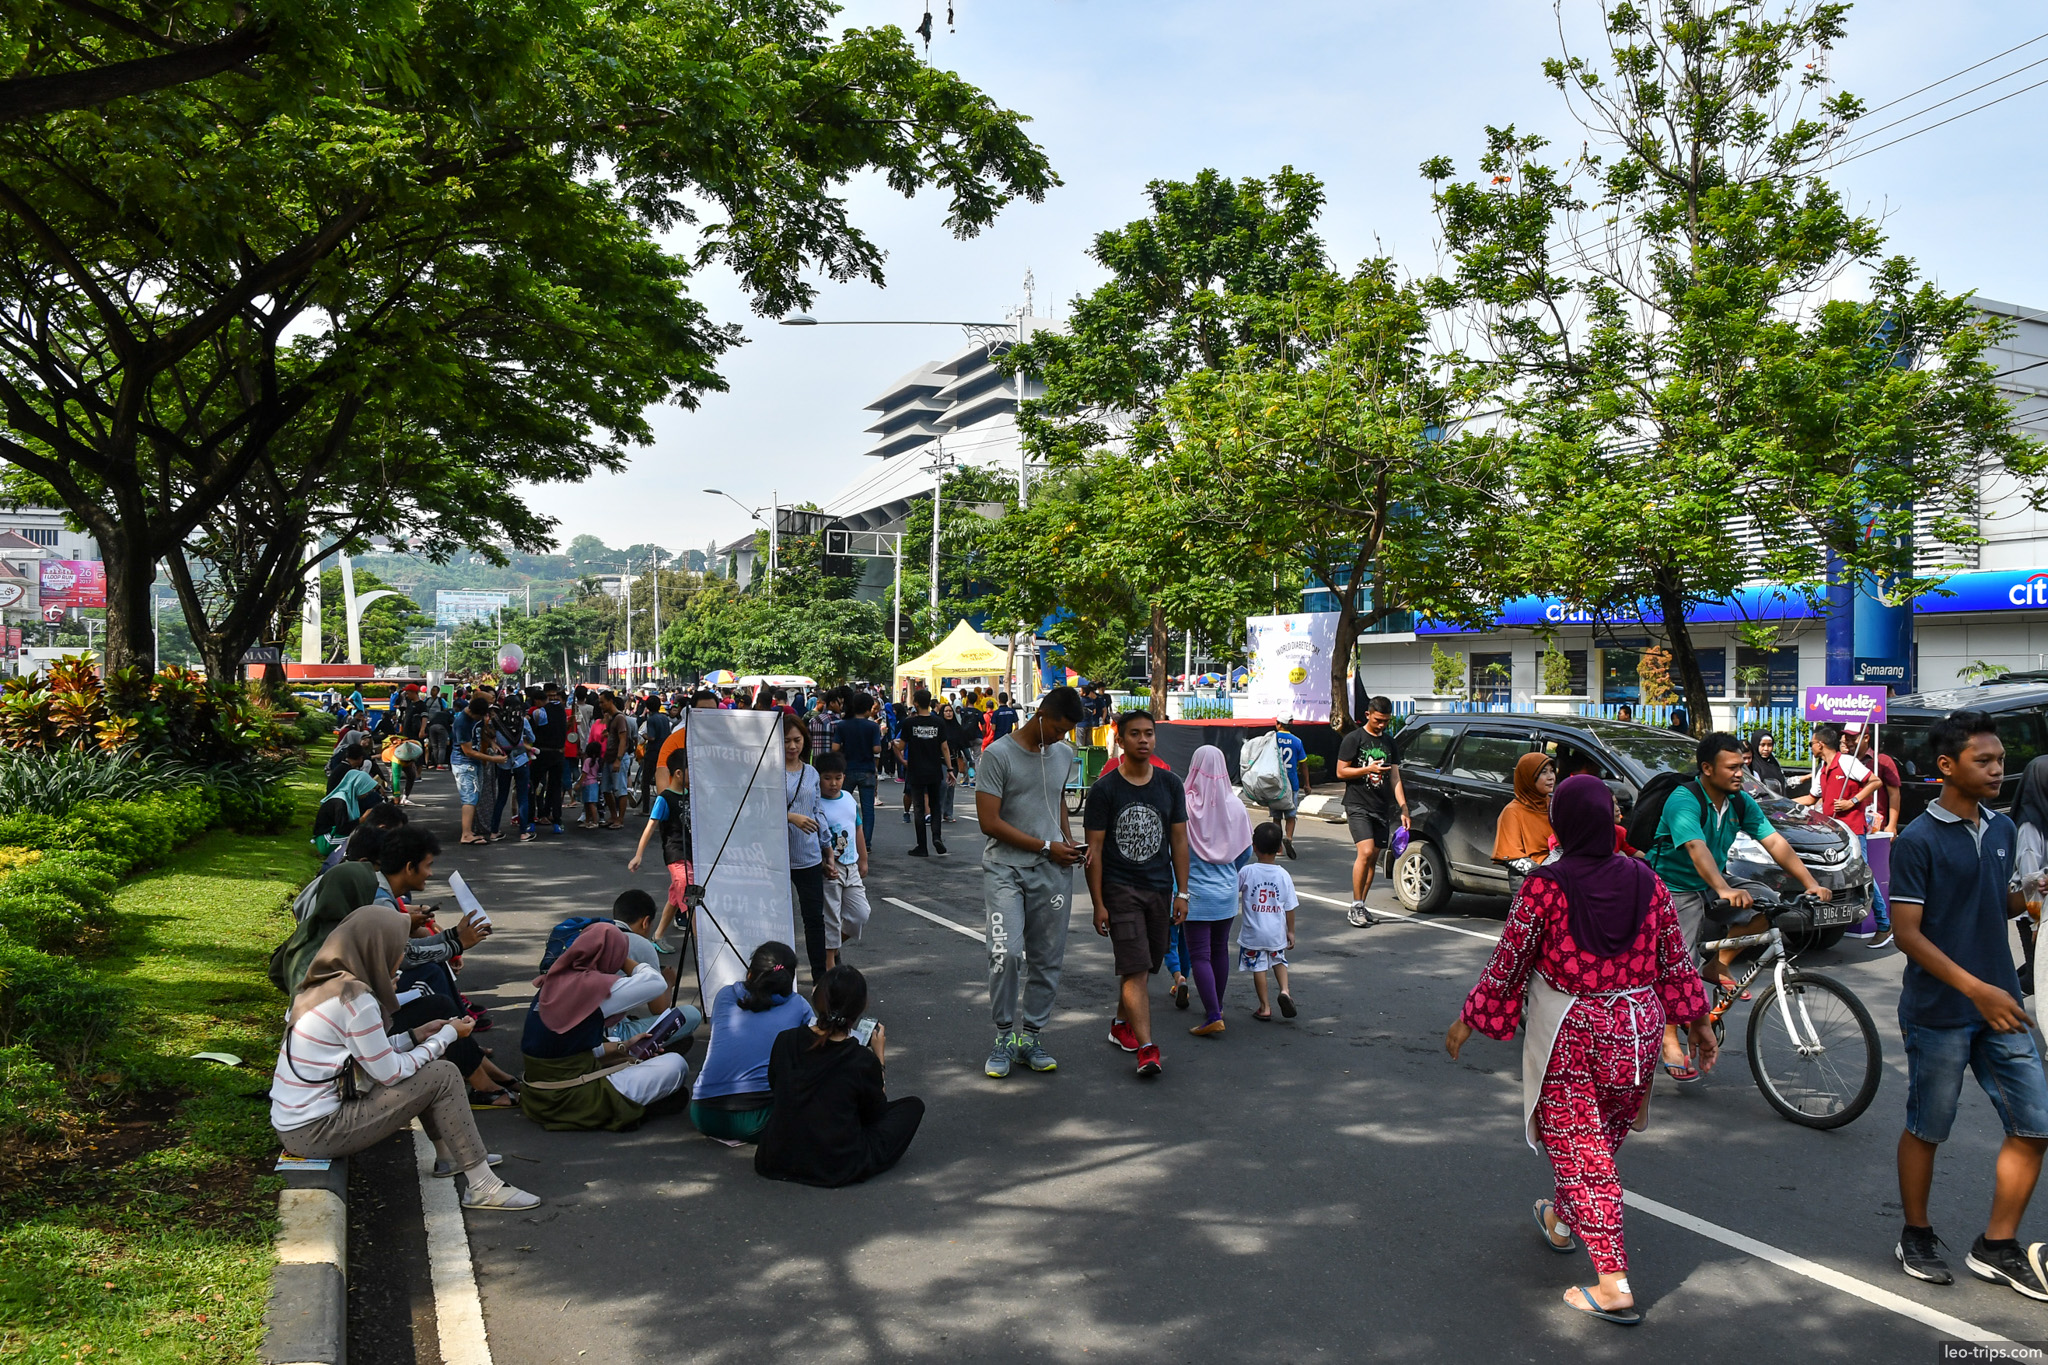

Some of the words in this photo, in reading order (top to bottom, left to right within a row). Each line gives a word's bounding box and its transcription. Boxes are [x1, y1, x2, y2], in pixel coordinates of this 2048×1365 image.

[79, 568, 92, 577] 26
[1276, 642, 1291, 656] WORLD
[1291, 640, 1311, 651] DIABETES
[1311, 644, 1321, 656] DAY
[1860, 662, 1904, 678] Semarang
[1251, 904, 1282, 913] GIBRAN
[991, 911, 1008, 974] adidas
